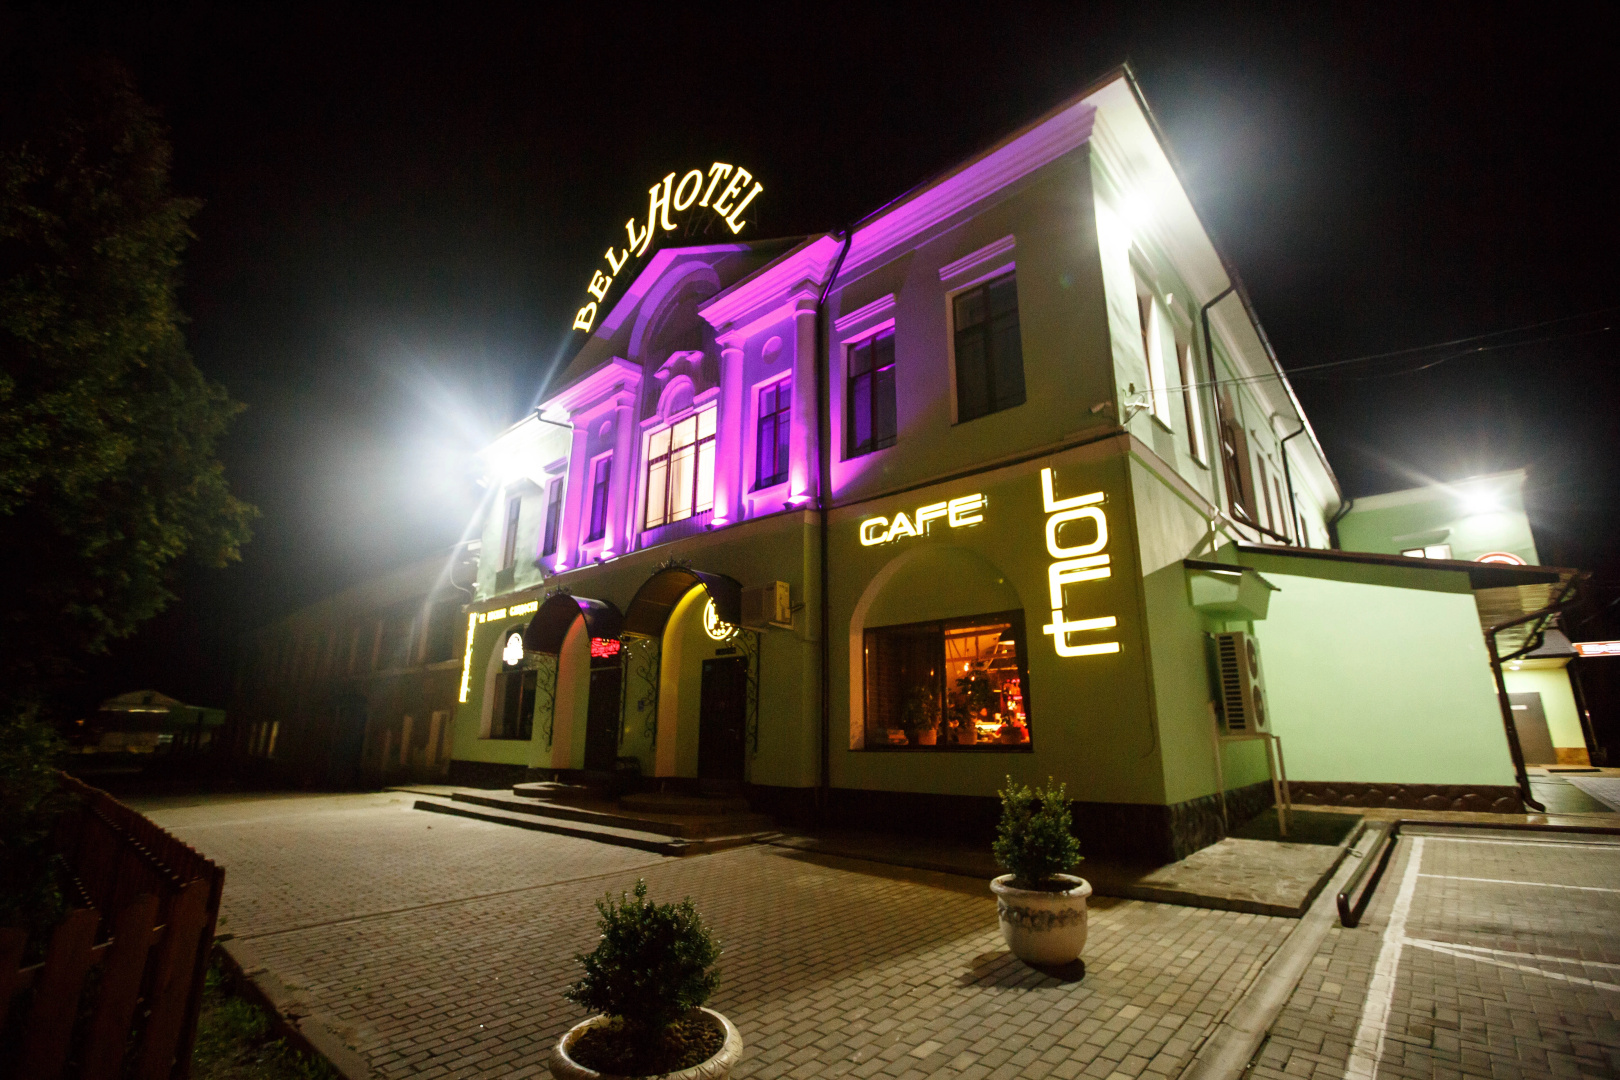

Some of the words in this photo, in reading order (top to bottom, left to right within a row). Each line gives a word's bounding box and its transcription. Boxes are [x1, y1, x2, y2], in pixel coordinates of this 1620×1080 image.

[573, 218, 646, 333] BELL
[637, 162, 763, 257] HOTEL
[860, 493, 983, 546] CAFE
